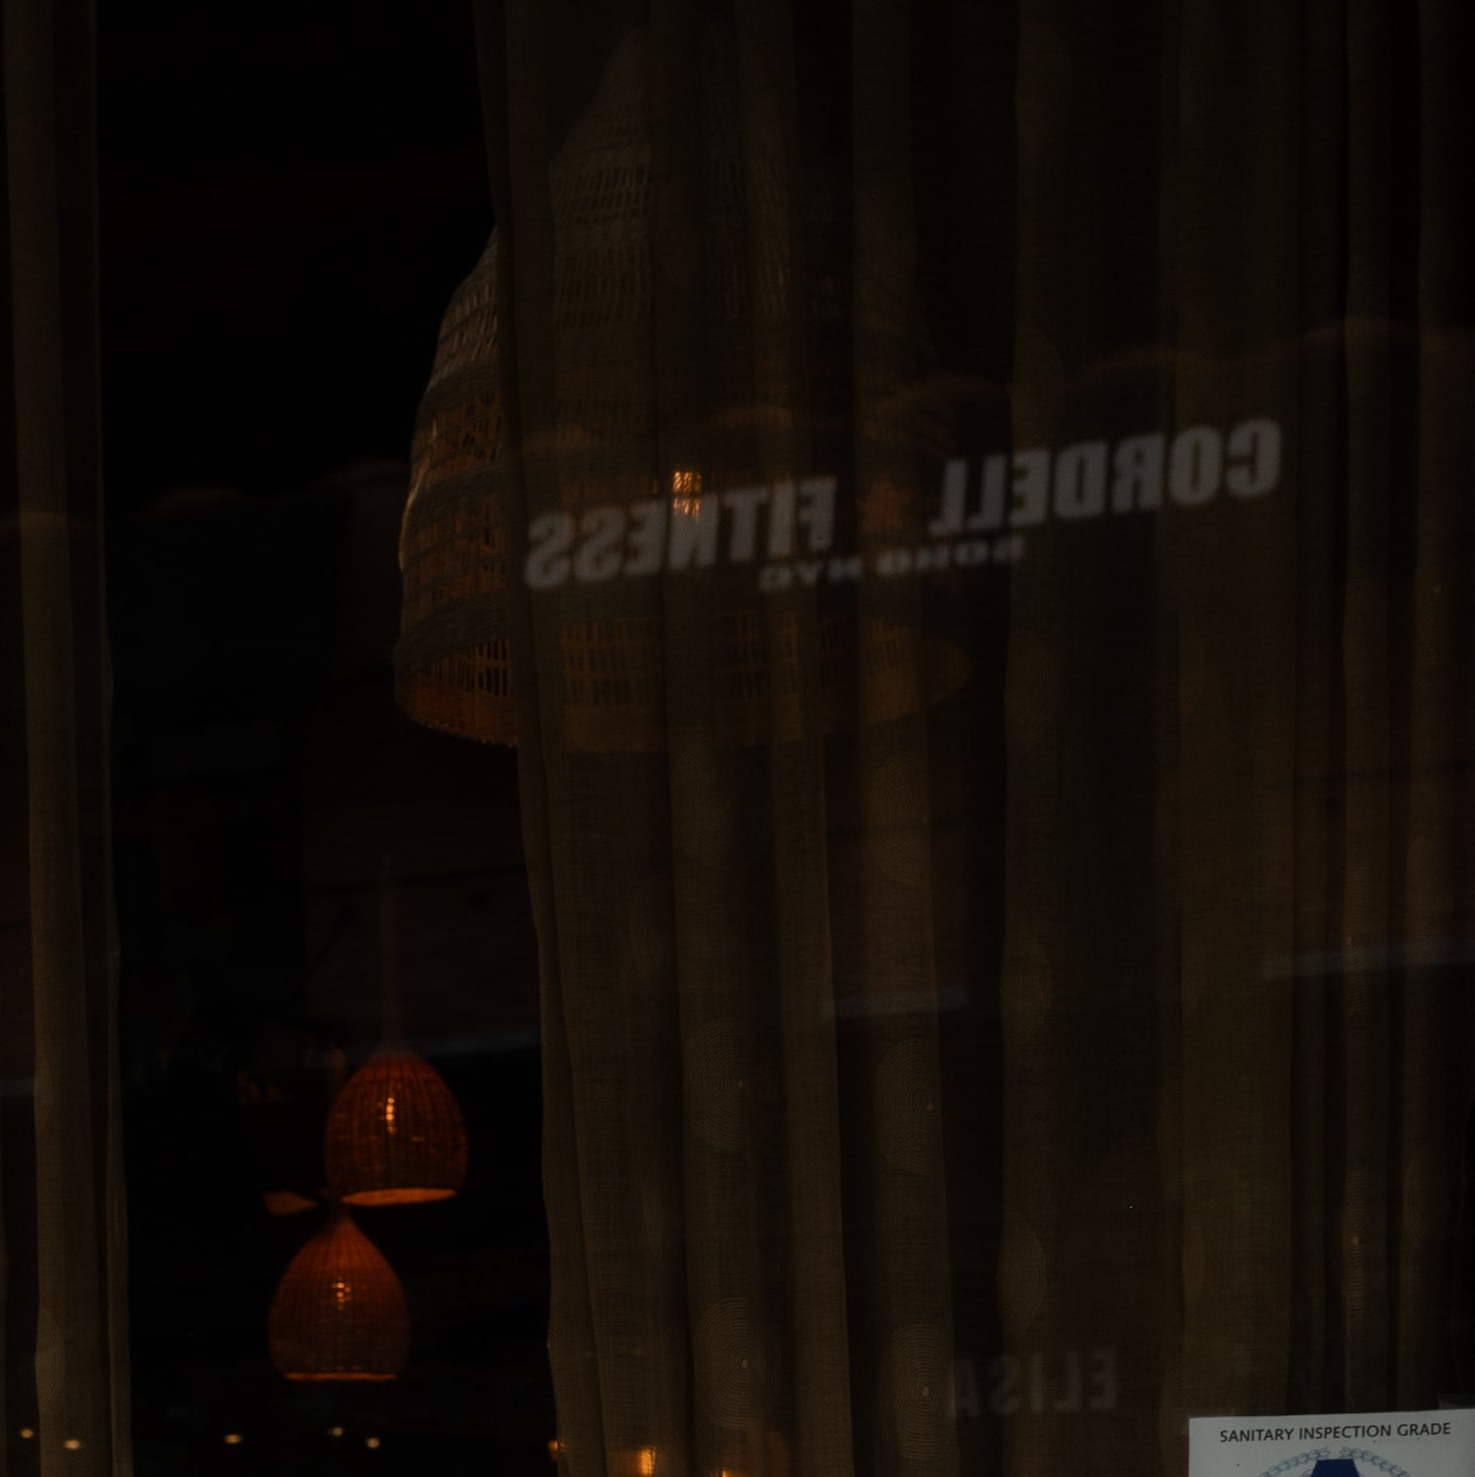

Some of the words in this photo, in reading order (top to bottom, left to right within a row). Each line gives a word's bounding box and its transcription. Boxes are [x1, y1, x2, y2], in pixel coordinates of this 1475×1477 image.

[1220, 1428, 1294, 1443] SANITARY
[1299, 1424, 1392, 1440] INSPECTION
[1397, 1422, 1452, 1437] GRADE
